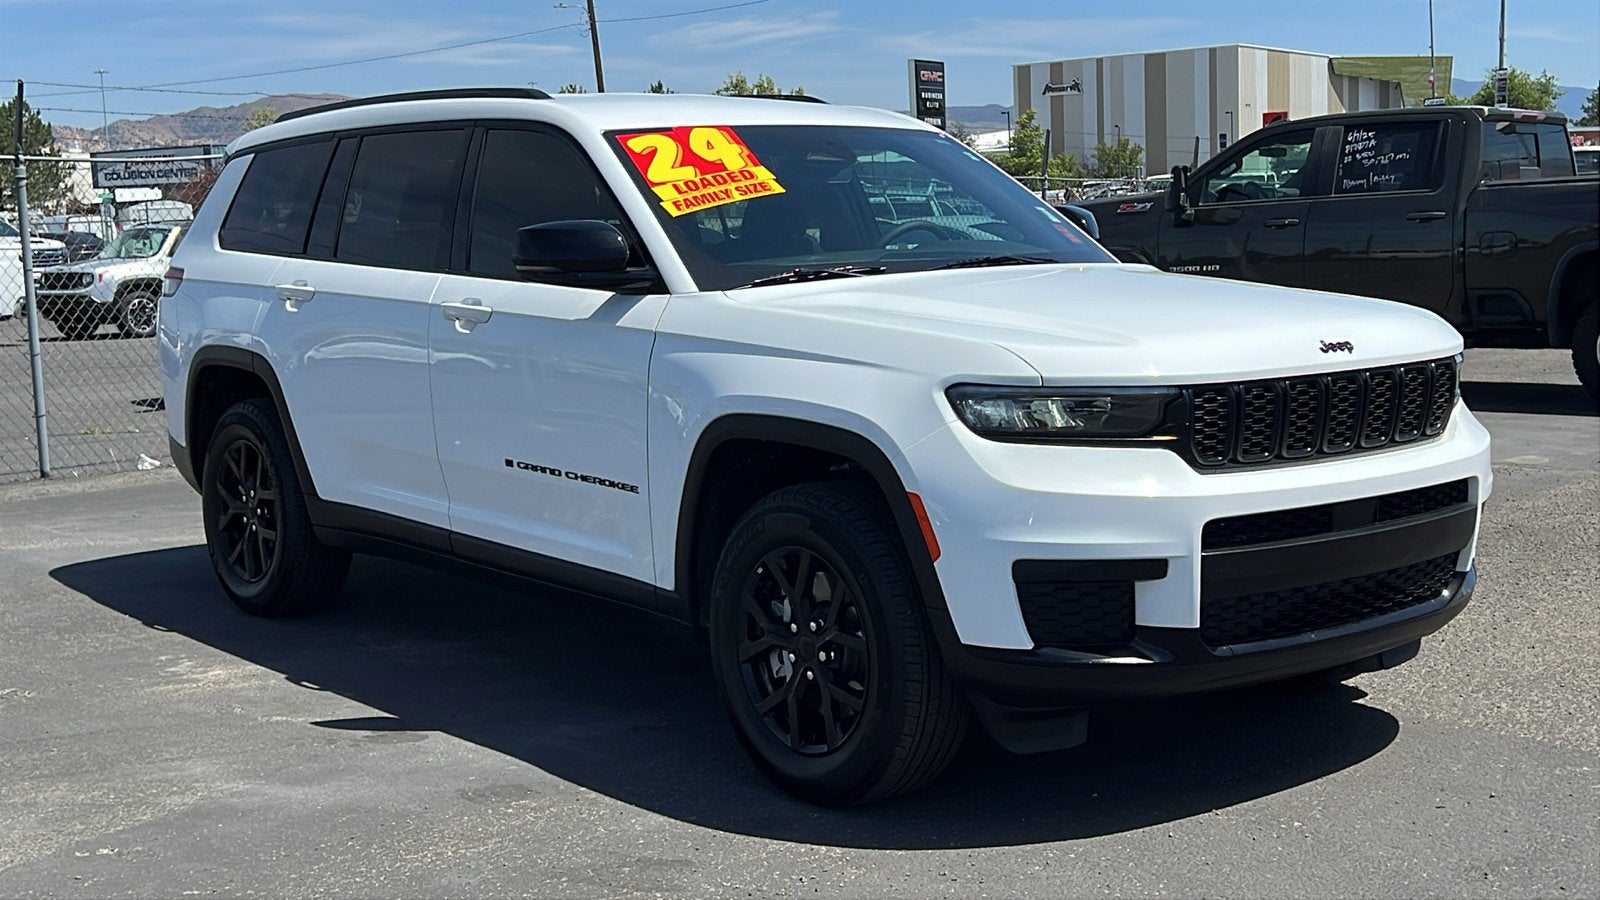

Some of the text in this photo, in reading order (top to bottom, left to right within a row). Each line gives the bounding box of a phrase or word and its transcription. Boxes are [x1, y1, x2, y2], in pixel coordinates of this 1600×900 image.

[920, 70, 943, 82] GMC
[626, 127, 750, 184] 24
[104, 167, 198, 181] COLLISION CENTER
[671, 169, 757, 195] LOADED
[672, 182, 776, 213] FAMILY SIZE
[1319, 340, 1355, 355] Jeep
[516, 461, 640, 495] GRAND CHEROKEE
